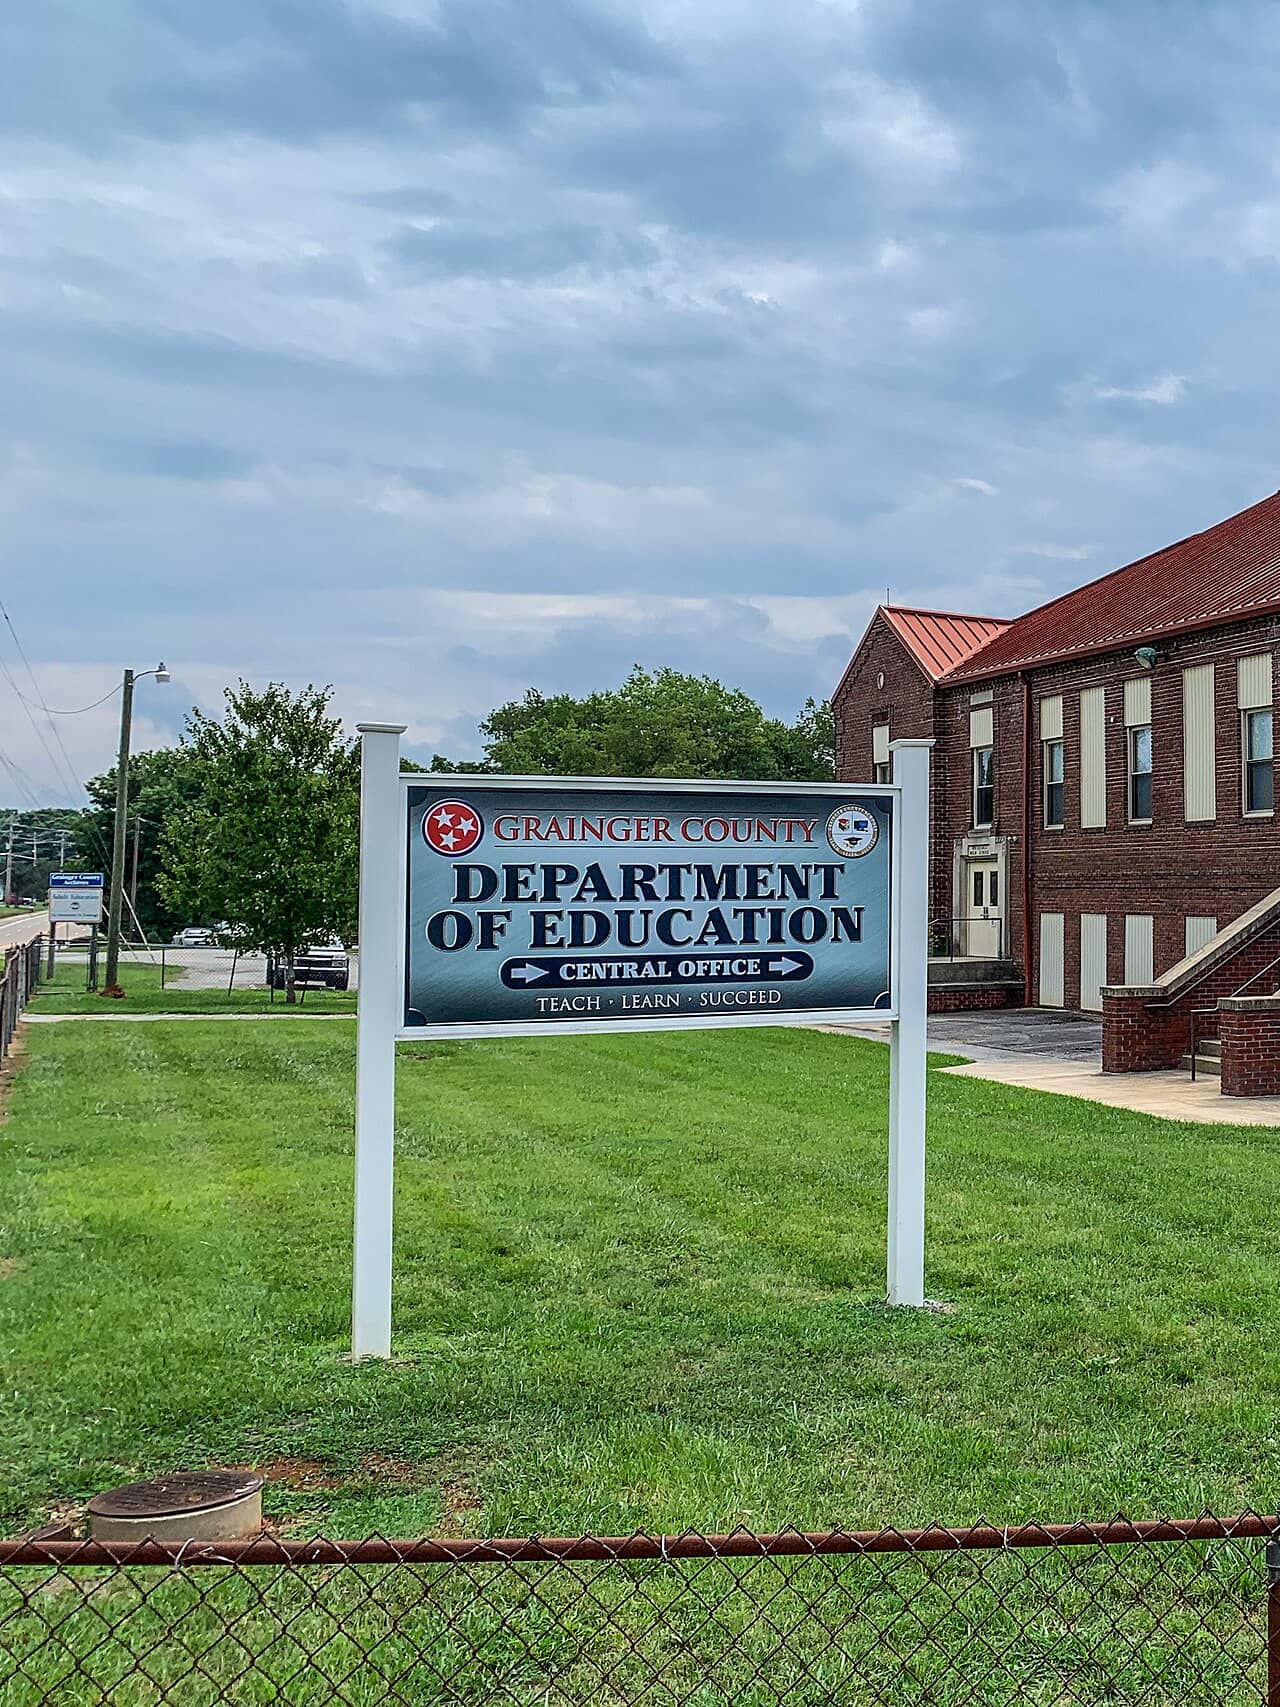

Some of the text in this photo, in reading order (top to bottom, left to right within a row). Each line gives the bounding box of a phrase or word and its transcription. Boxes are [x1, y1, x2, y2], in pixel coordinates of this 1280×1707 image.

[493, 815, 676, 842] GRAINGER
[680, 817, 818, 843] COUNTY
[451, 862, 845, 904] DEPARTMENT
[427, 905, 865, 951] OF EDUCATION
[559, 958, 761, 981] CENTRAL OFFICE
[535, 990, 781, 1012] TEACH LEARN SUCCEED
